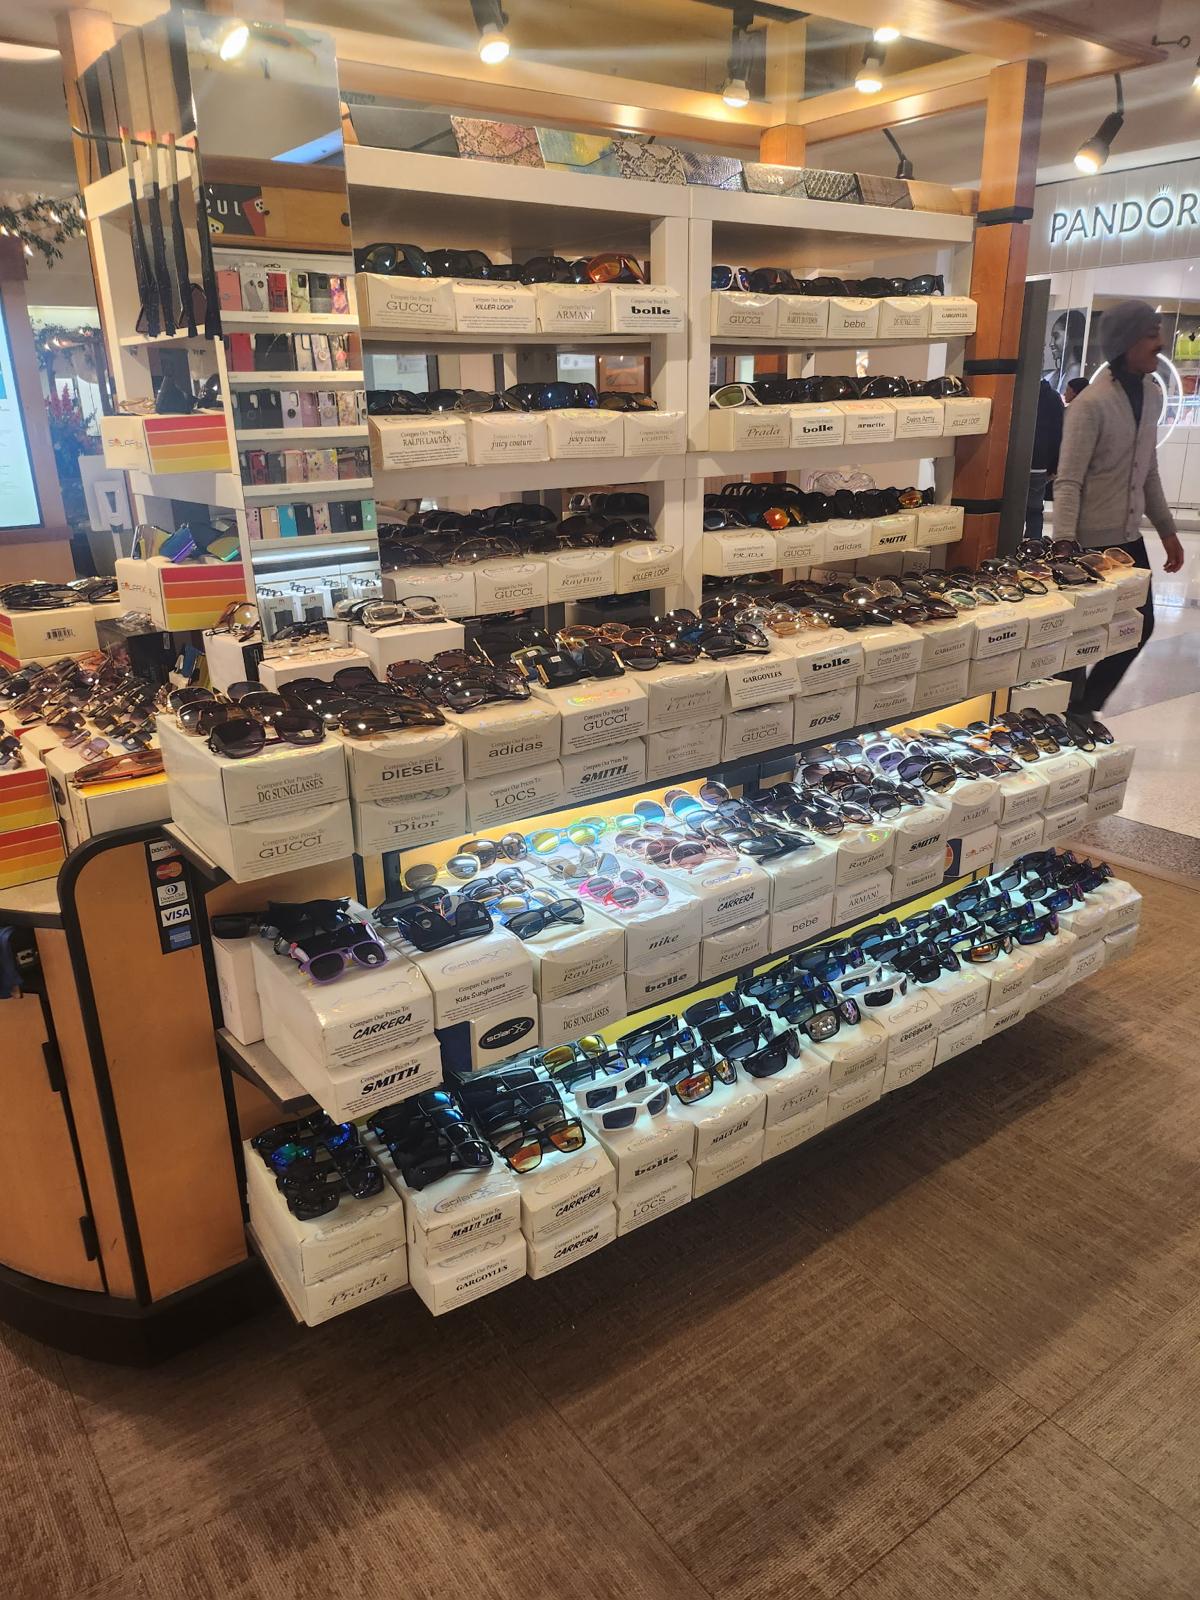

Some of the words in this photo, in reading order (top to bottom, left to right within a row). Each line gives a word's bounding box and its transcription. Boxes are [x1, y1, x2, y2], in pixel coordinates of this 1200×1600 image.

[386, 301, 433, 313] GUCCI
[556, 310, 593, 320] ARMANI
[630, 306, 671, 315] bolle
[729, 315, 761, 325] GUCCI
[843, 319, 866, 328] bebe
[747, 427, 781, 437] Prada
[802, 424, 834, 434] bolle
[491, 440, 508, 450] juicy
[509, 440, 533, 448] couture
[832, 542, 862, 552] adidas
[879, 534, 907, 546] SMITH
[783, 549, 811, 558] GUCCI
[631, 570, 653, 582] KILLER
[653, 567, 670, 578] LOOP
[494, 587, 534, 600] GUCCI
[988, 631, 1017, 644] bolle
[1075, 645, 1100, 656] SMITH
[811, 657, 851, 672] bolle
[742, 670, 783, 684] GARGOYLES
[583, 713, 628, 732] GUCCI
[809, 712, 841, 729] BOSS
[741, 727, 778, 743] GUCCI
[488, 741, 543, 758] adidas
[382, 762, 445, 781] DIESEL
[580, 763, 629, 784] SMITH
[257, 790, 272, 803] DG
[272, 777, 324, 799] SUNGLASSES
[494, 787, 537, 808] LOCS
[393, 819, 439, 834] Dior
[259, 834, 322, 859] GUCCI
[909, 833, 941, 852] SMITH
[717, 891, 755, 912] CARRERA
[848, 890, 879, 907] ARMANI
[164, 908, 190, 921] VISA
[792, 916, 819, 933] bebe
[649, 934, 680, 950] nike
[458, 980, 480, 992] Compare
[480, 977, 490, 985] Our
[490, 974, 504, 982] Prices
[644, 973, 688, 993] bolle
[455, 995, 471, 1004] Kids
[471, 983, 506, 999] Sunglasses
[349, 1018, 373, 1029] Compare
[385, 1009, 401, 1018] Prices
[353, 1012, 412, 1040] CARRERA
[563, 1019, 573, 1030] DG
[573, 1006, 610, 1027] SUNGLASSES
[360, 1072, 383, 1083] Compare
[383, 1067, 394, 1075] Our
[394, 1061, 410, 1070] Prices
[361, 1063, 421, 1096] SMITH
[634, 1153, 678, 1177] bolle
[555, 1186, 601, 1217] CARRERA
[633, 1195, 666, 1217] LOCS
[450, 1219, 470, 1229] Compare
[480, 1210, 494, 1218] Prices
[482, 1212, 503, 1226] JIM
[553, 1231, 599, 1259] CARRERA
[456, 1264, 508, 1291] GARGOYLES
[328, 1274, 389, 1306] Prada
